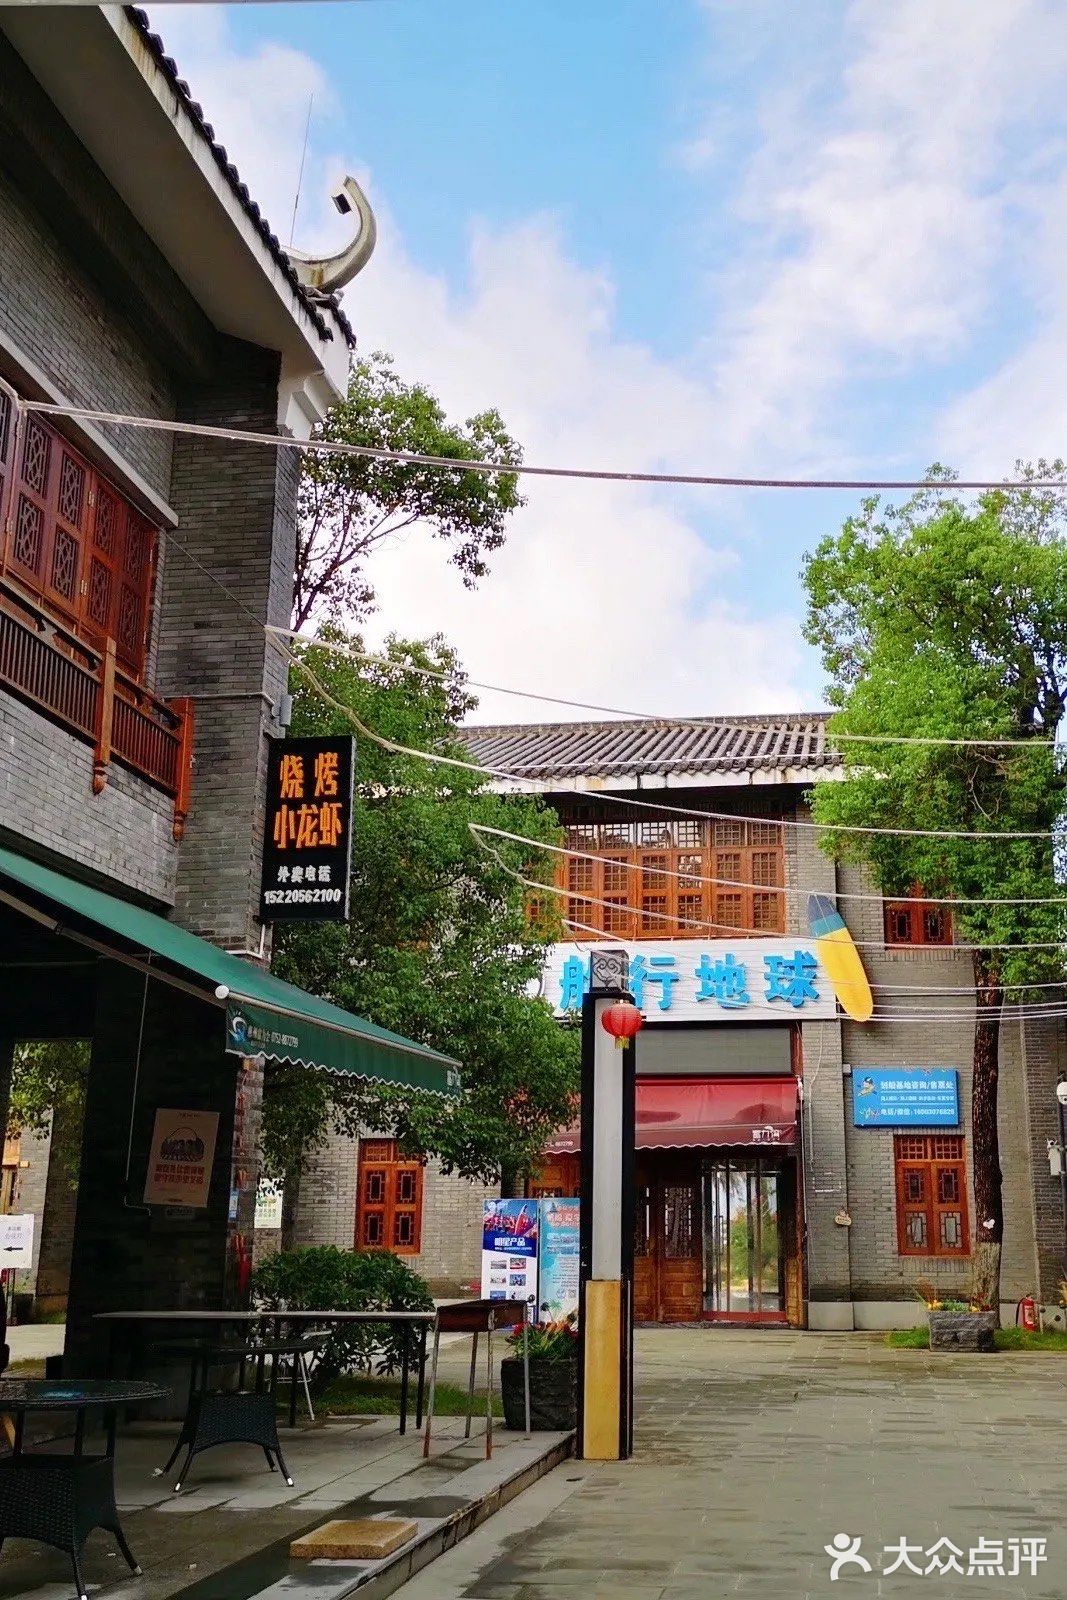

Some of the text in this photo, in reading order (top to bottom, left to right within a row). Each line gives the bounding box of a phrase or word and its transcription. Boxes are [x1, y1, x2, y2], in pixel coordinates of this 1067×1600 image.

[279, 752, 340, 798] 烧烤
[273, 802, 343, 849] 小龙虾
